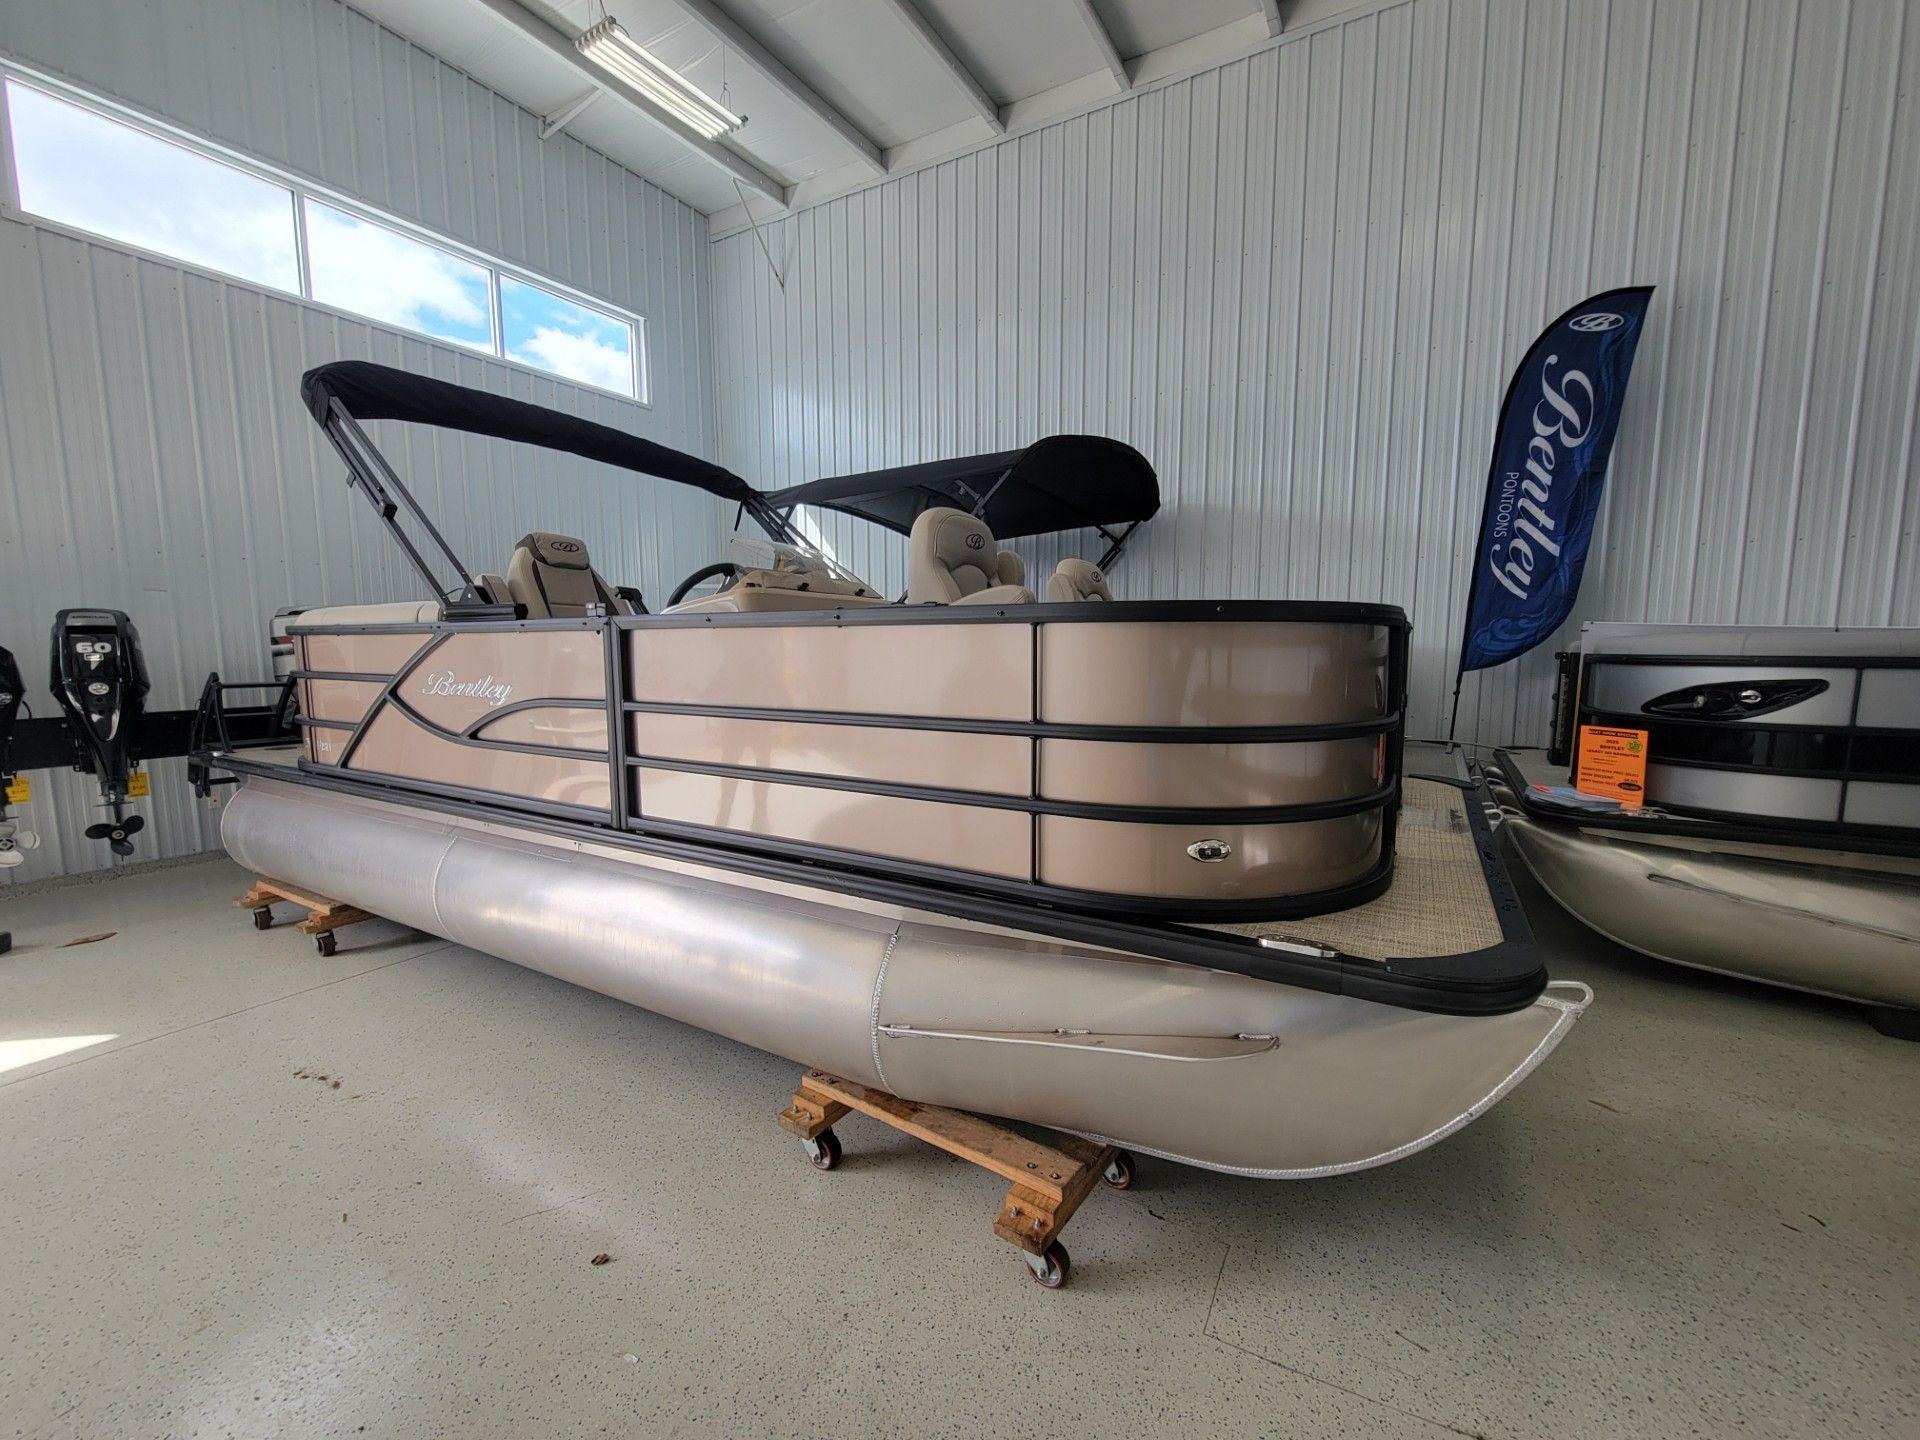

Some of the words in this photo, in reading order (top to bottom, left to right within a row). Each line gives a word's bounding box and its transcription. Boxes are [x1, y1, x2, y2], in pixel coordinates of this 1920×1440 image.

[1490, 354, 1594, 600] Bentley
[1493, 471, 1520, 538] PONTOONS
[76, 642, 112, 653] 60
[422, 670, 512, 706] Bentley
